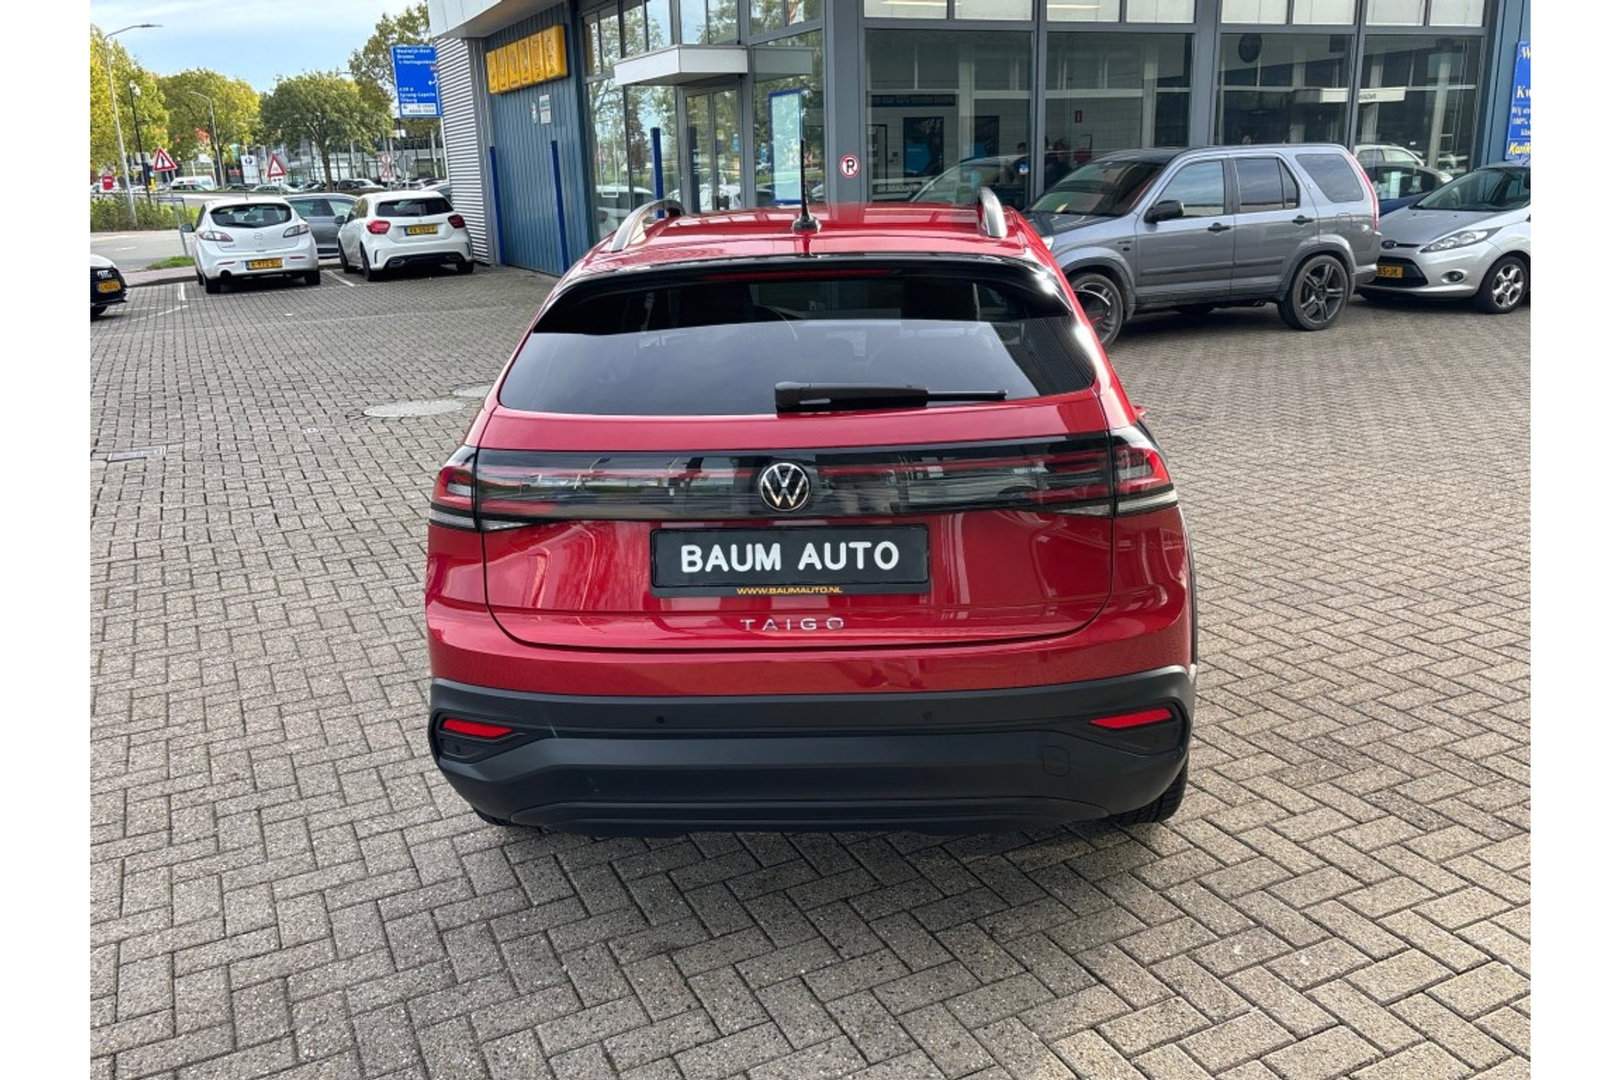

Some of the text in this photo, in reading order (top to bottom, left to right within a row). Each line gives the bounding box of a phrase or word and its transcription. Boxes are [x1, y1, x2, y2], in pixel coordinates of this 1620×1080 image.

[680, 541, 899, 573] BAUM AUTO
[736, 586, 843, 595] WWW.BAUMAUTO.NL
[740, 617, 845, 631] TAIGO
